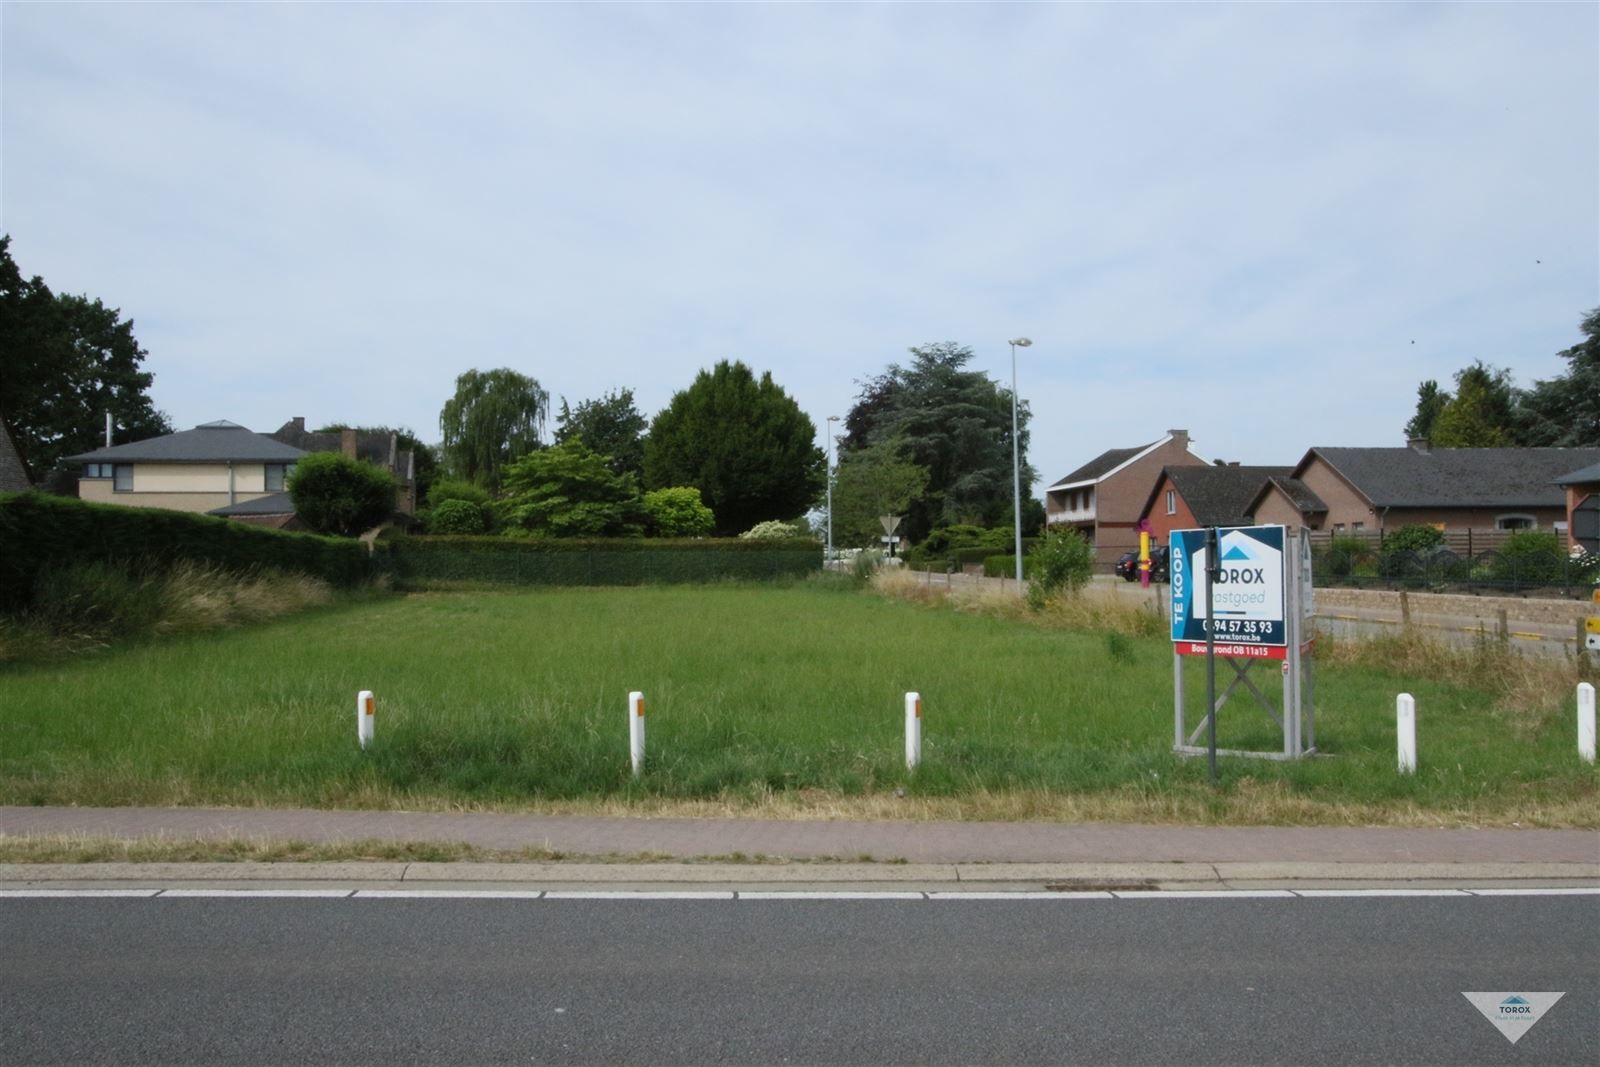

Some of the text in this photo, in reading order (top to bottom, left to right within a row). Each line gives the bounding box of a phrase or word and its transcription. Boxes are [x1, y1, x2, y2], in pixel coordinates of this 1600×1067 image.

[1217, 568, 1264, 584] OROX
[1173, 548, 1183, 624] TE KOOP
[1214, 590, 1264, 606] astgoed
[1203, 620, 1272, 633] 094 57 35 93
[1246, 646, 1268, 656] 11a15
